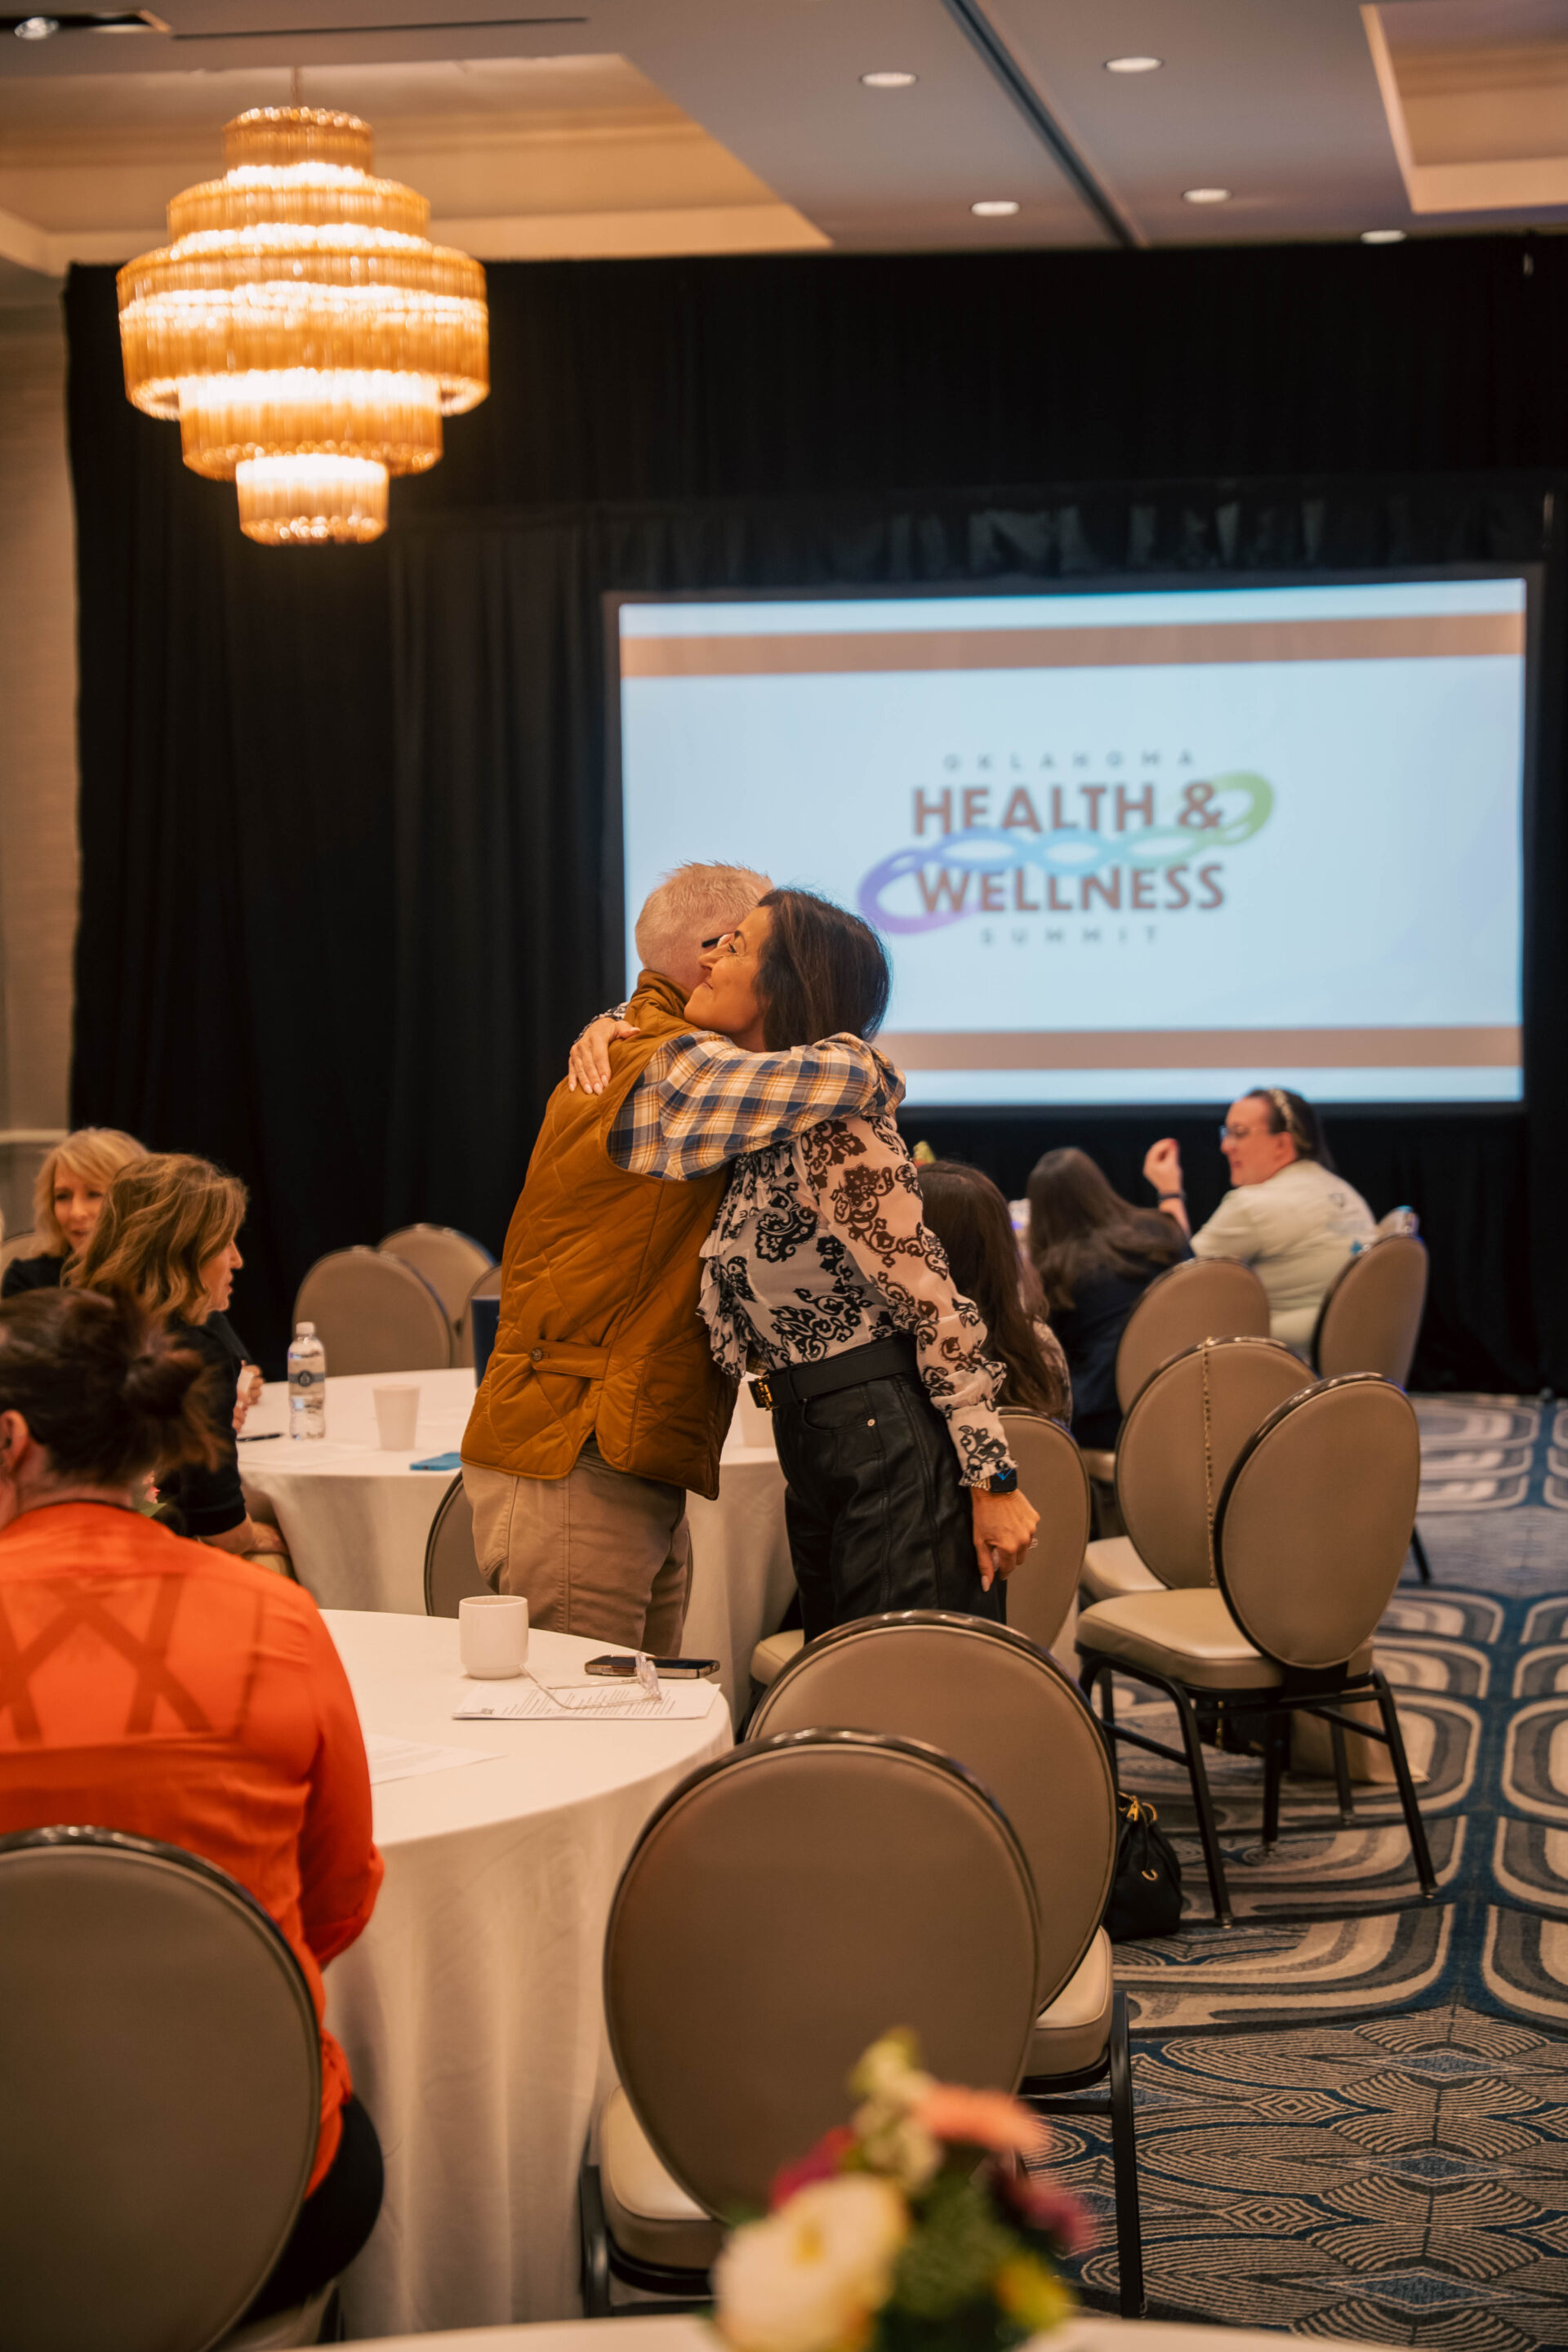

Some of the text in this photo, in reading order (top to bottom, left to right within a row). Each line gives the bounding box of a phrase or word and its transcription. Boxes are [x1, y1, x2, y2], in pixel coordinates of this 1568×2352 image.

[943, 751, 1194, 771] OKLAHOMA
[912, 782, 1223, 835] HEALTH &
[915, 863, 1225, 914] WELLNESS
[982, 925, 1157, 945] SUMMIT
